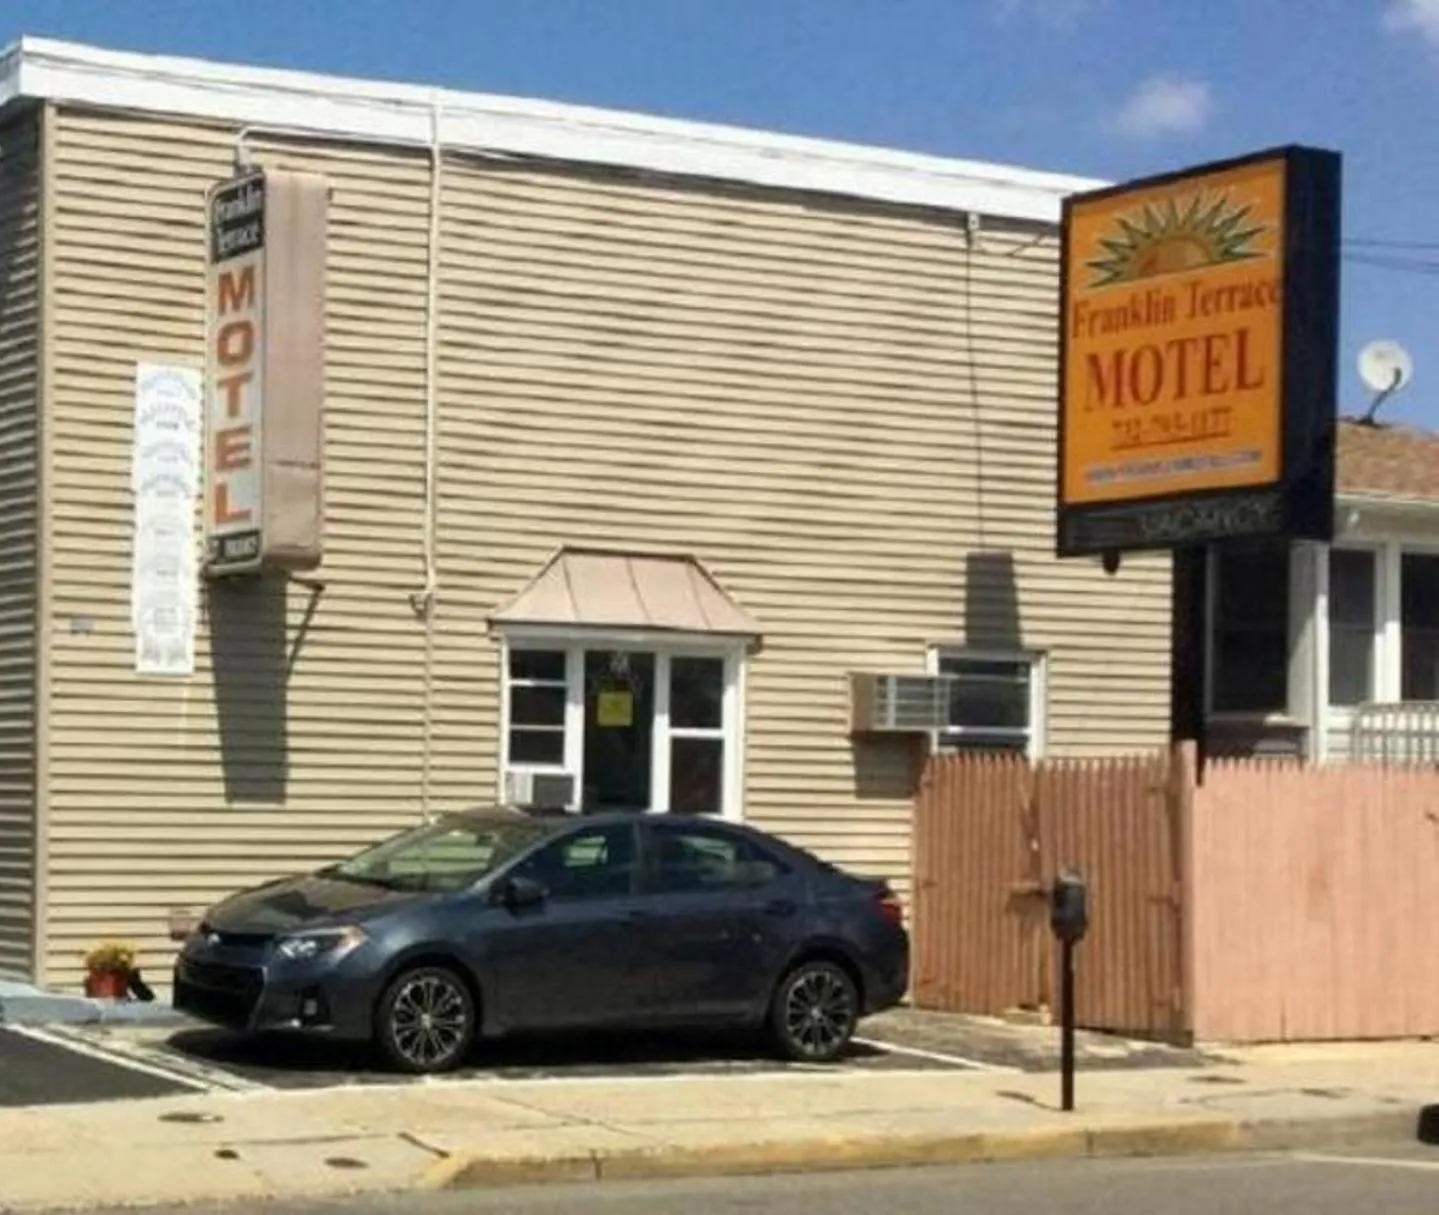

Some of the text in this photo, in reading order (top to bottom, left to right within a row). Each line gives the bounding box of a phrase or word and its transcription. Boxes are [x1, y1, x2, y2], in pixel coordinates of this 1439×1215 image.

[1072, 279, 1278, 338] Franklin Terrace
[213, 264, 255, 526] MOTEL
[1083, 326, 1266, 412] MOTEL
